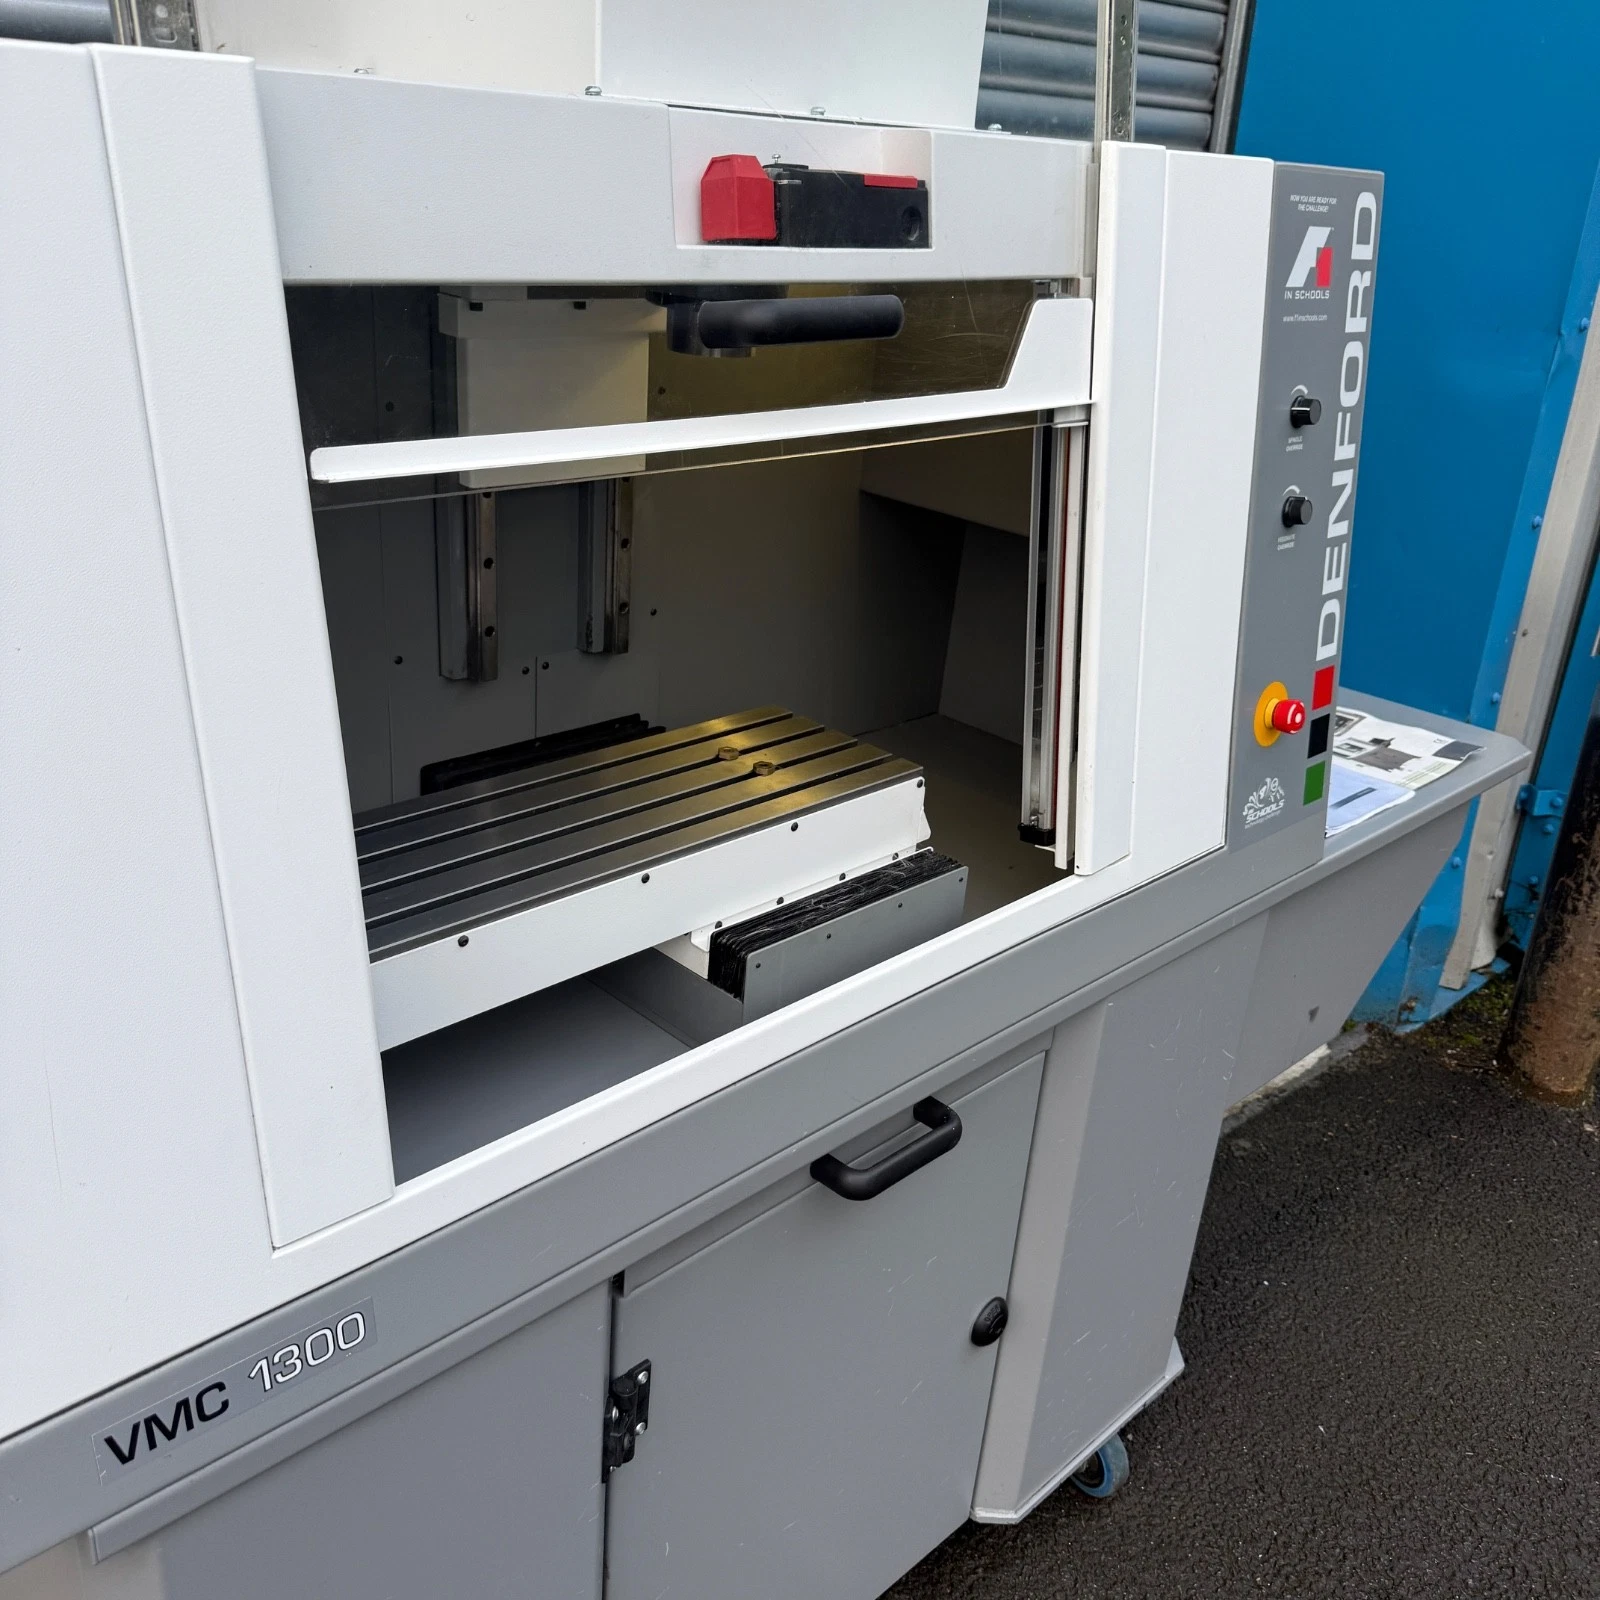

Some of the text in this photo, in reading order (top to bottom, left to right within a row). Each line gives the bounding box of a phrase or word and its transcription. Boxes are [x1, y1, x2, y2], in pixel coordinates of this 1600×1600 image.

[1284, 290, 1330, 300] IN SCHOOLS
[1315, 191, 1377, 662] DENFORD
[1246, 799, 1285, 823] SCHOOLS
[104, 1311, 366, 1465] VMC 1300
